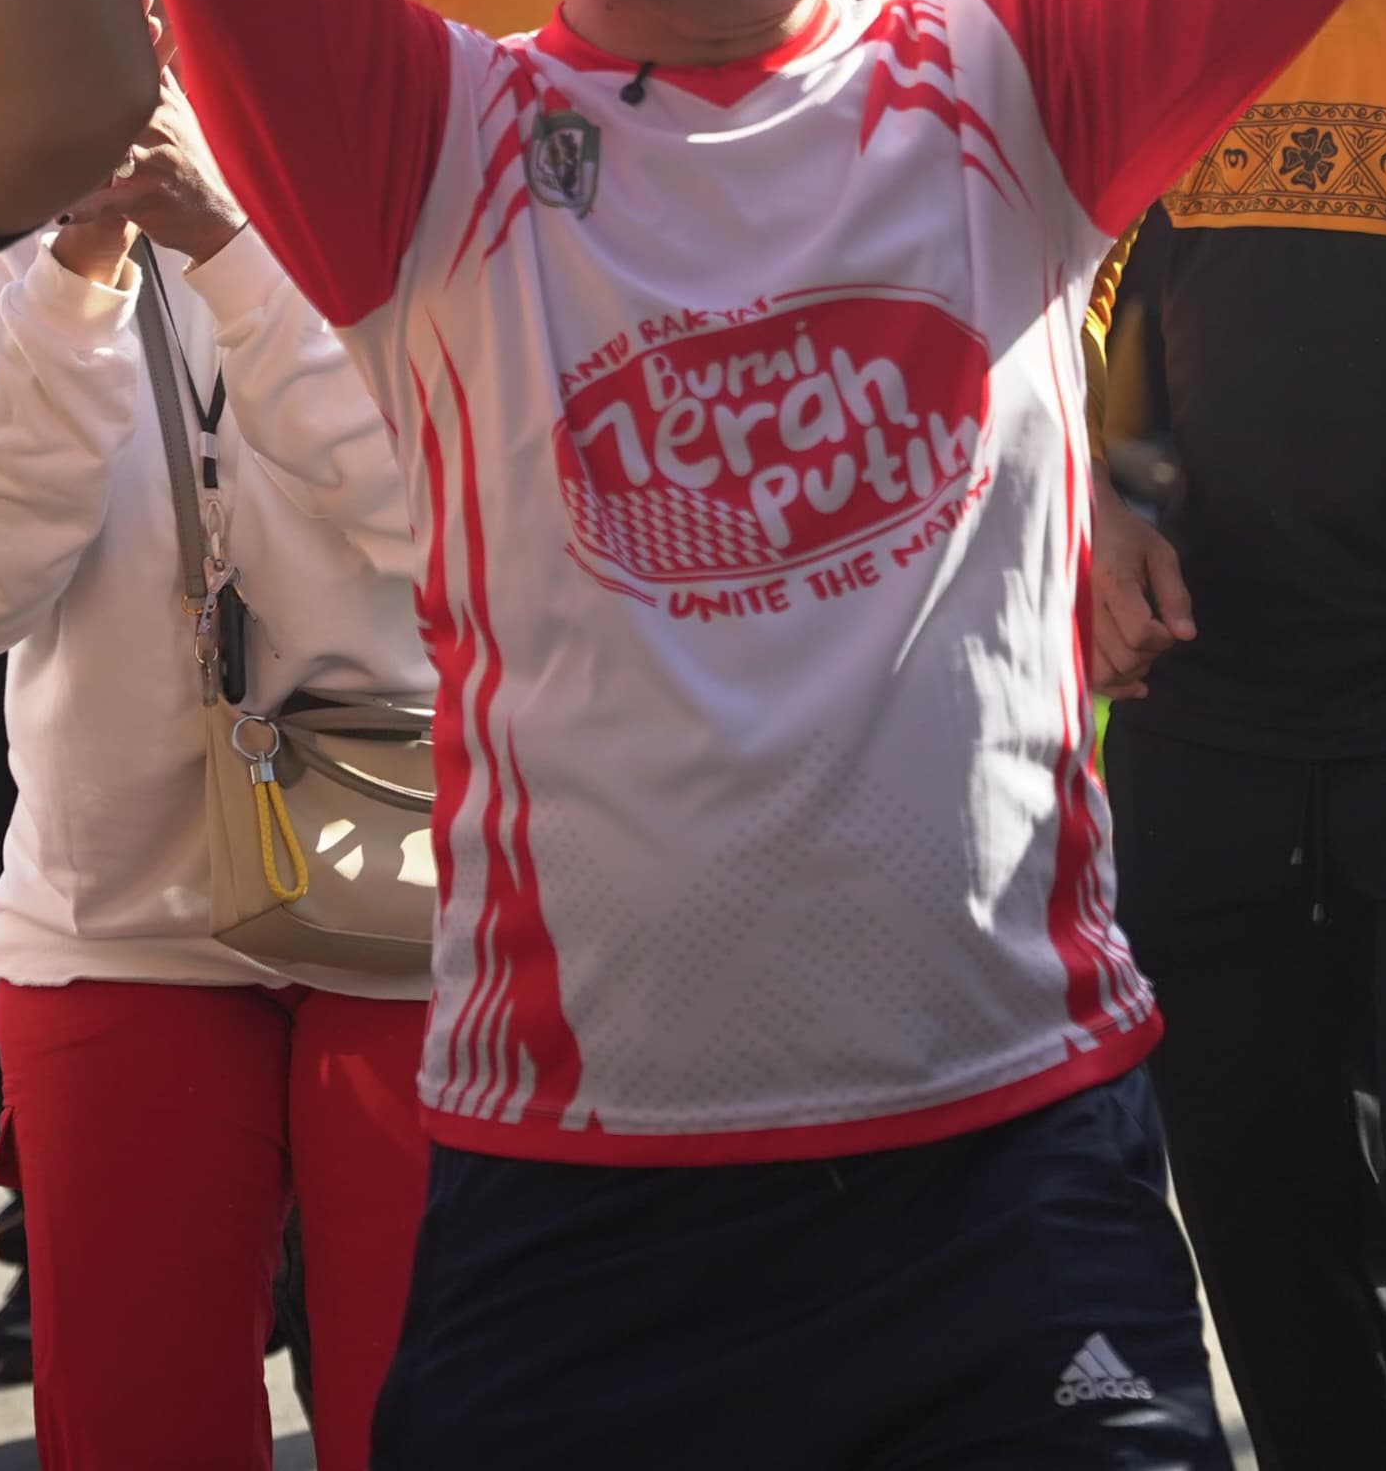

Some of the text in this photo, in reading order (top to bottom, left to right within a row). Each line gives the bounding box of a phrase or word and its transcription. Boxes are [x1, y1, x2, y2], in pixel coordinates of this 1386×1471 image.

[559, 330, 630, 396] ANTU
[642, 319, 819, 413] Bumi
[666, 581, 792, 624] UNITE
[803, 550, 882, 600] THE
[1054, 1375, 1153, 1406] adidas
